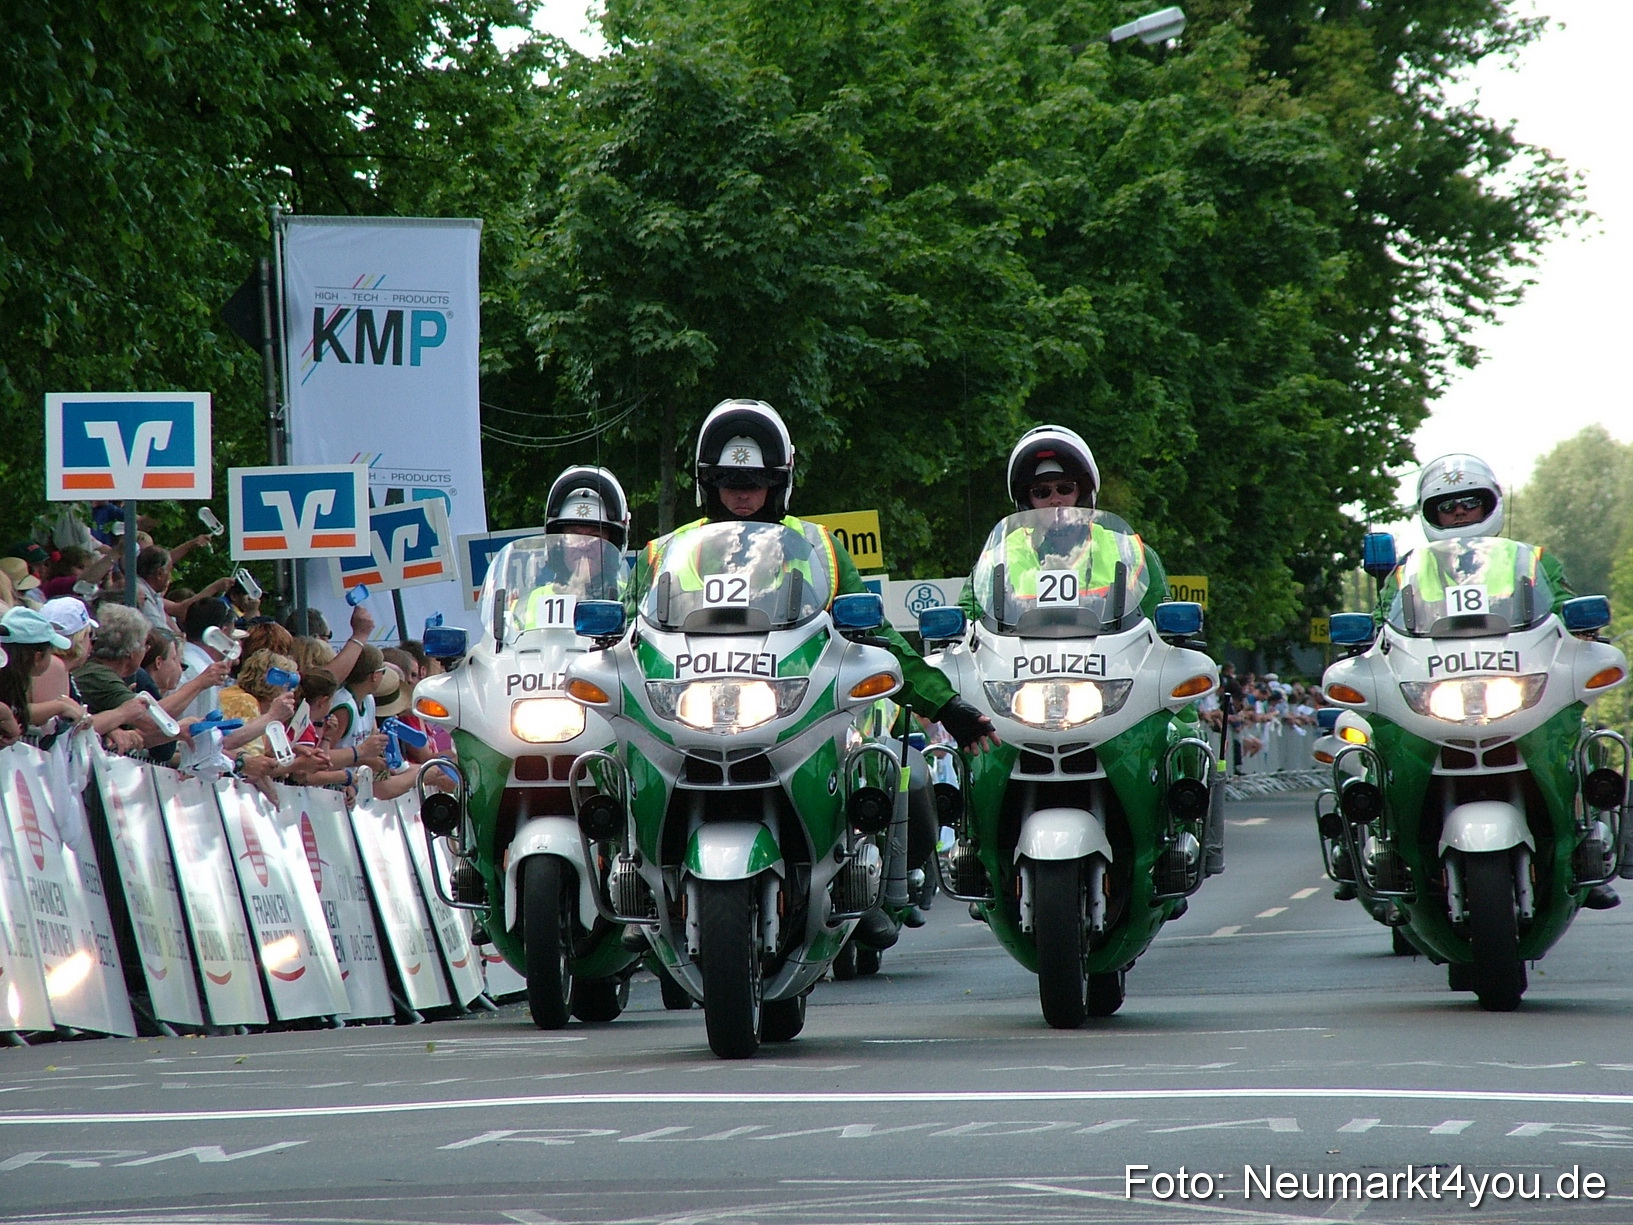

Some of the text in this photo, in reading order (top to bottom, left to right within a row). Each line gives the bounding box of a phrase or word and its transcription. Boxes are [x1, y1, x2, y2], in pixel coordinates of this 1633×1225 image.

[314, 291, 450, 305] HIGH TECH PRODUCTS
[313, 306, 448, 367] KMP
[391, 472, 452, 483] PRODUCTS
[705, 577, 747, 603] 02
[1039, 573, 1077, 602] 20
[1451, 588, 1483, 612] 18
[544, 598, 565, 624] 11
[675, 651, 777, 679] POLIZEI
[1013, 653, 1107, 679] POLIZEI
[1427, 651, 1520, 678] POLIZEI
[26, 876, 69, 918] FRANKEN
[251, 894, 292, 924] FRANKEN
